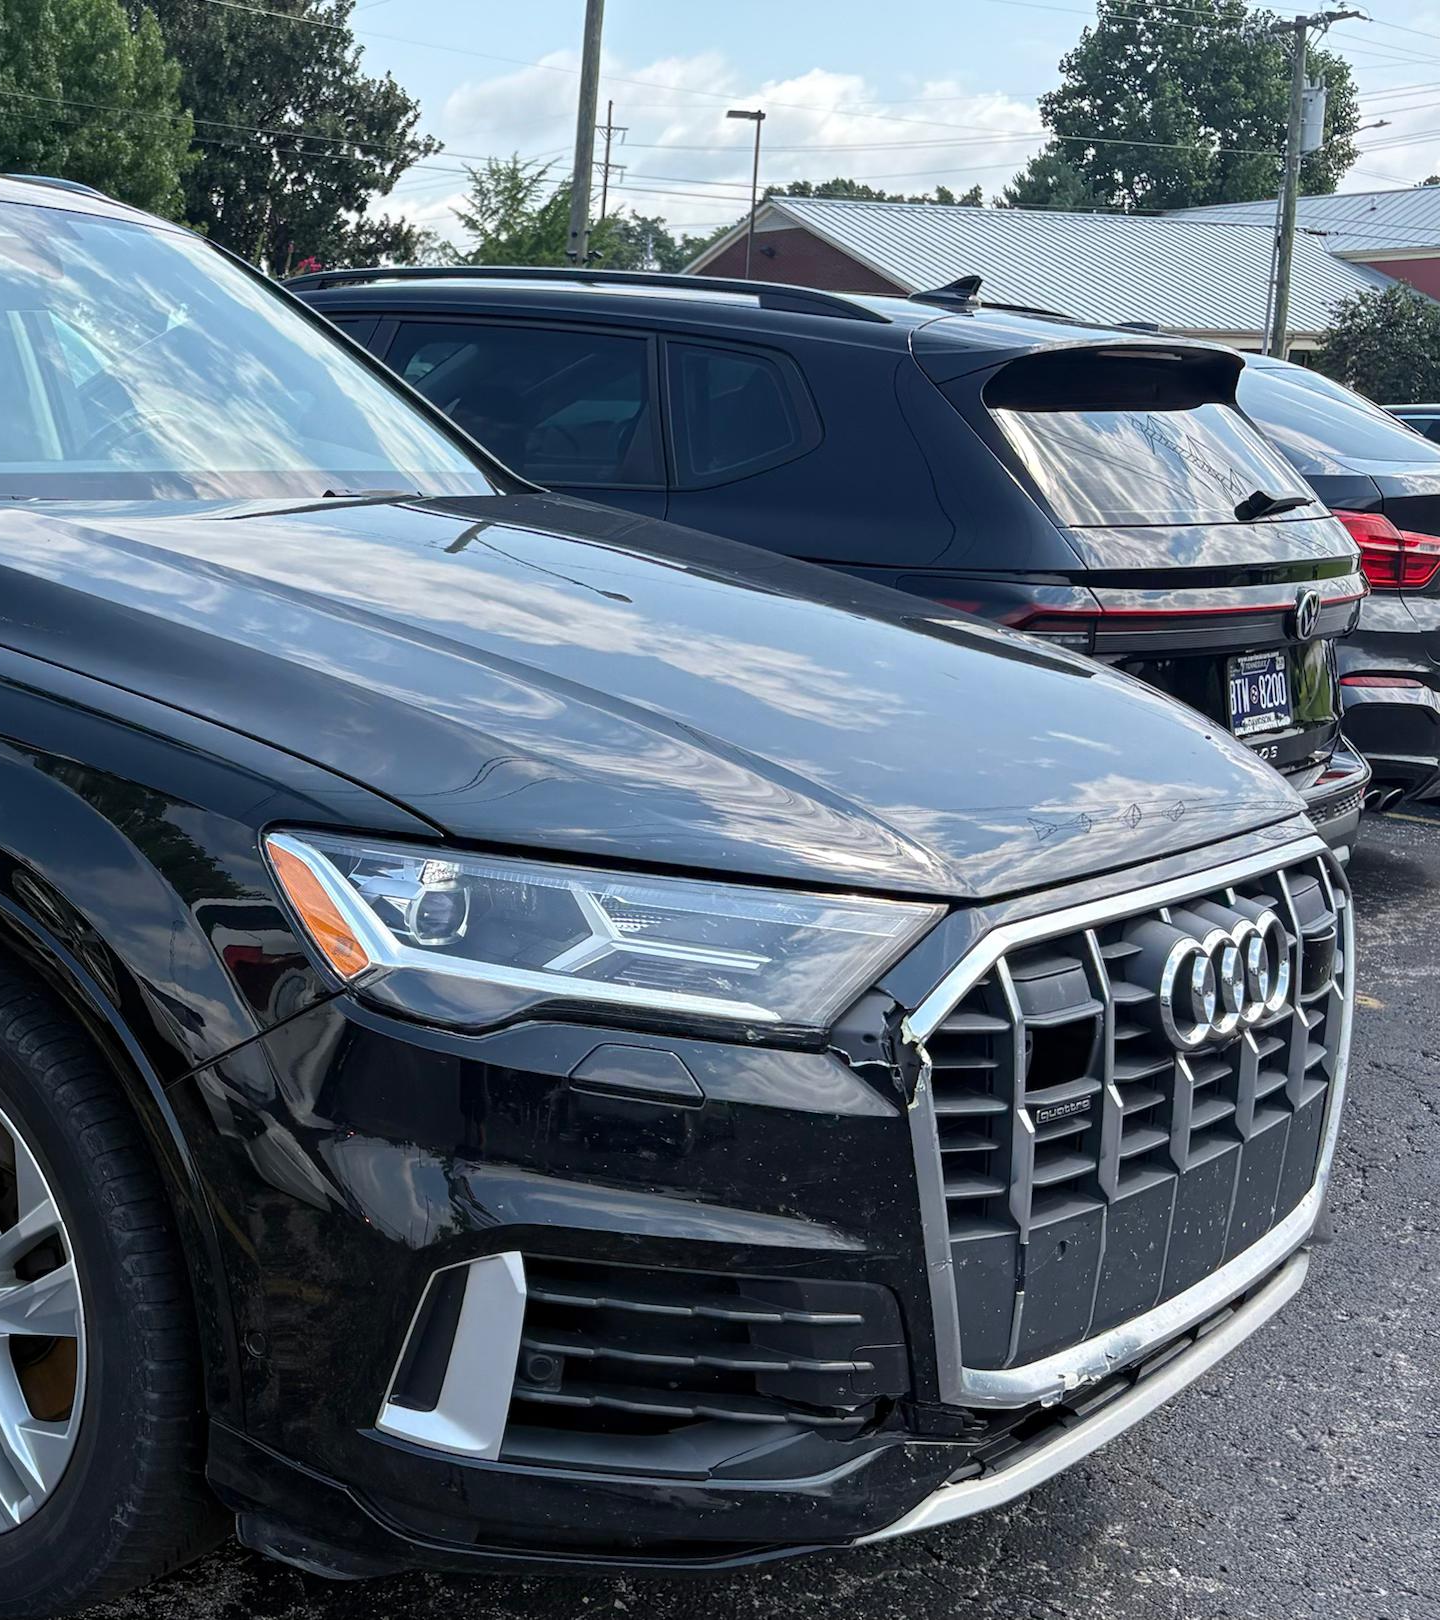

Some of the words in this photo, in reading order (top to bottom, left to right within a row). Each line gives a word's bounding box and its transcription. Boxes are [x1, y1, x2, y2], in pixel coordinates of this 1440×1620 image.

[1229, 677, 1250, 715] BTW
[1258, 671, 1287, 709] 8200
[1254, 745, 1278, 760] OS
[1040, 1099, 1090, 1120] quattro
